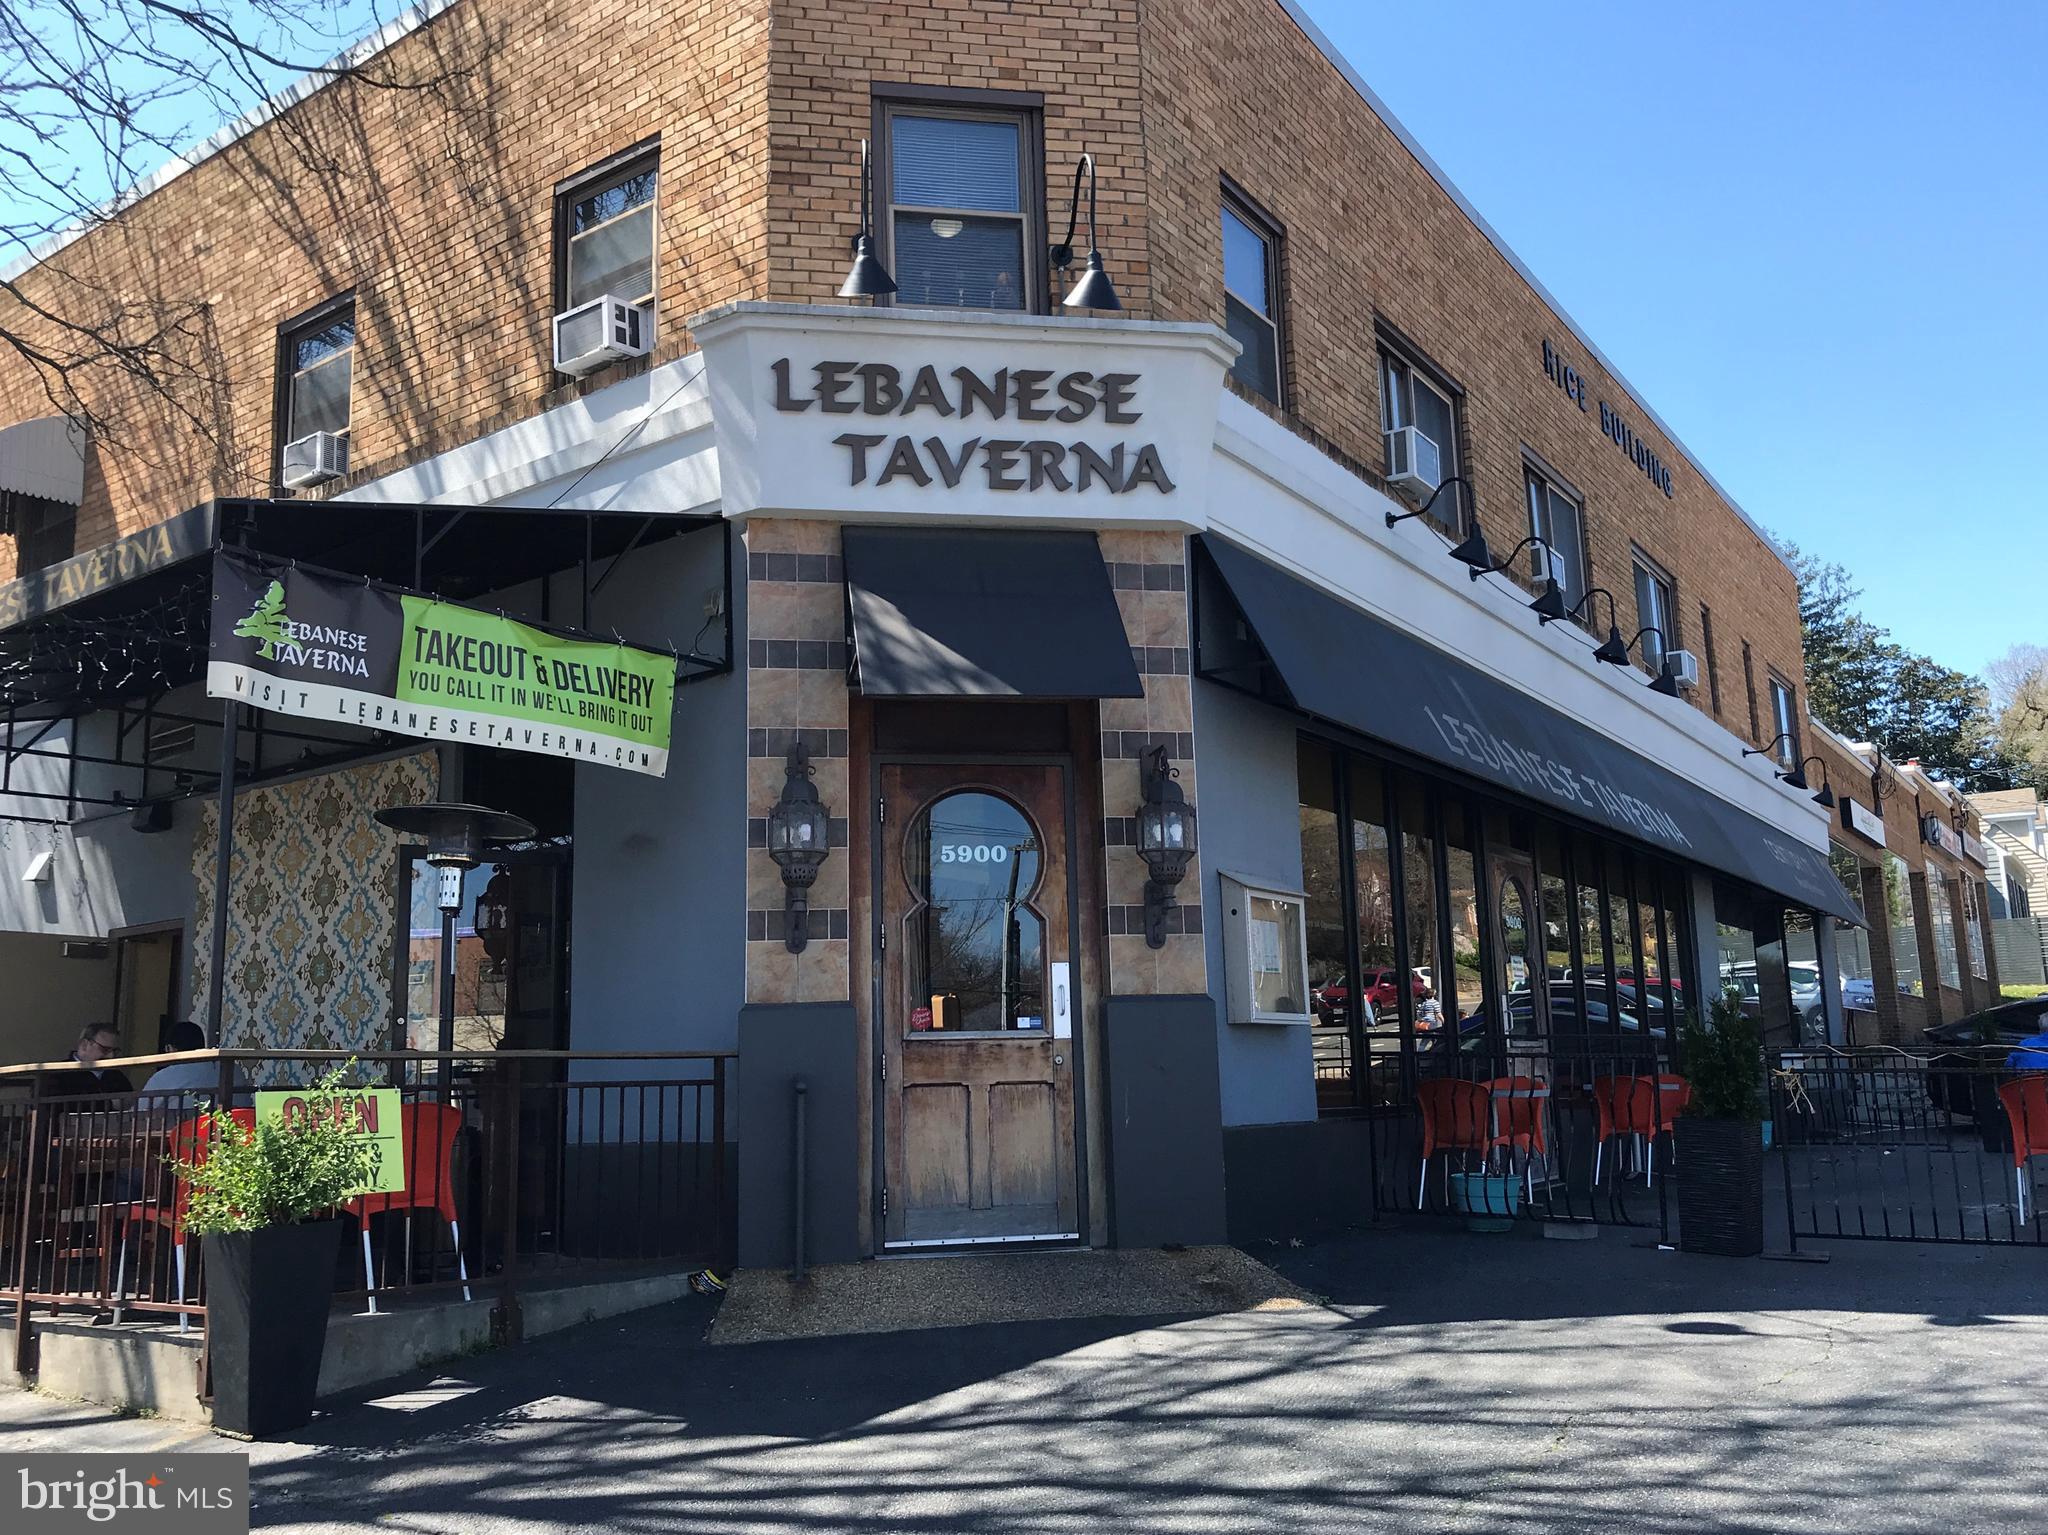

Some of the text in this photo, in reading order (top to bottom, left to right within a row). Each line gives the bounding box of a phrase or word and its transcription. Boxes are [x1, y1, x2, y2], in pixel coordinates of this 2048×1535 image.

[770, 358, 1143, 424] LEBANESE
[832, 432, 1176, 495] TAVERNA
[1599, 401, 1673, 499] BUILDING
[43, 525, 173, 606] TAVERNA
[273, 641, 370, 679] TAVERNA
[280, 620, 368, 653] LEBANESE
[414, 625, 655, 709] TAKEOUT & DELIVERY
[235, 675, 649, 768] VISIT LEBANESETAVERNA.COM
[409, 669, 653, 734] YOU CALL IT IN WE'LL BRING IT OUT
[1424, 705, 1693, 849] LEBANESE TAVERNA
[940, 844, 1008, 864] 5900
[282, 1093, 379, 1136] OPEN
